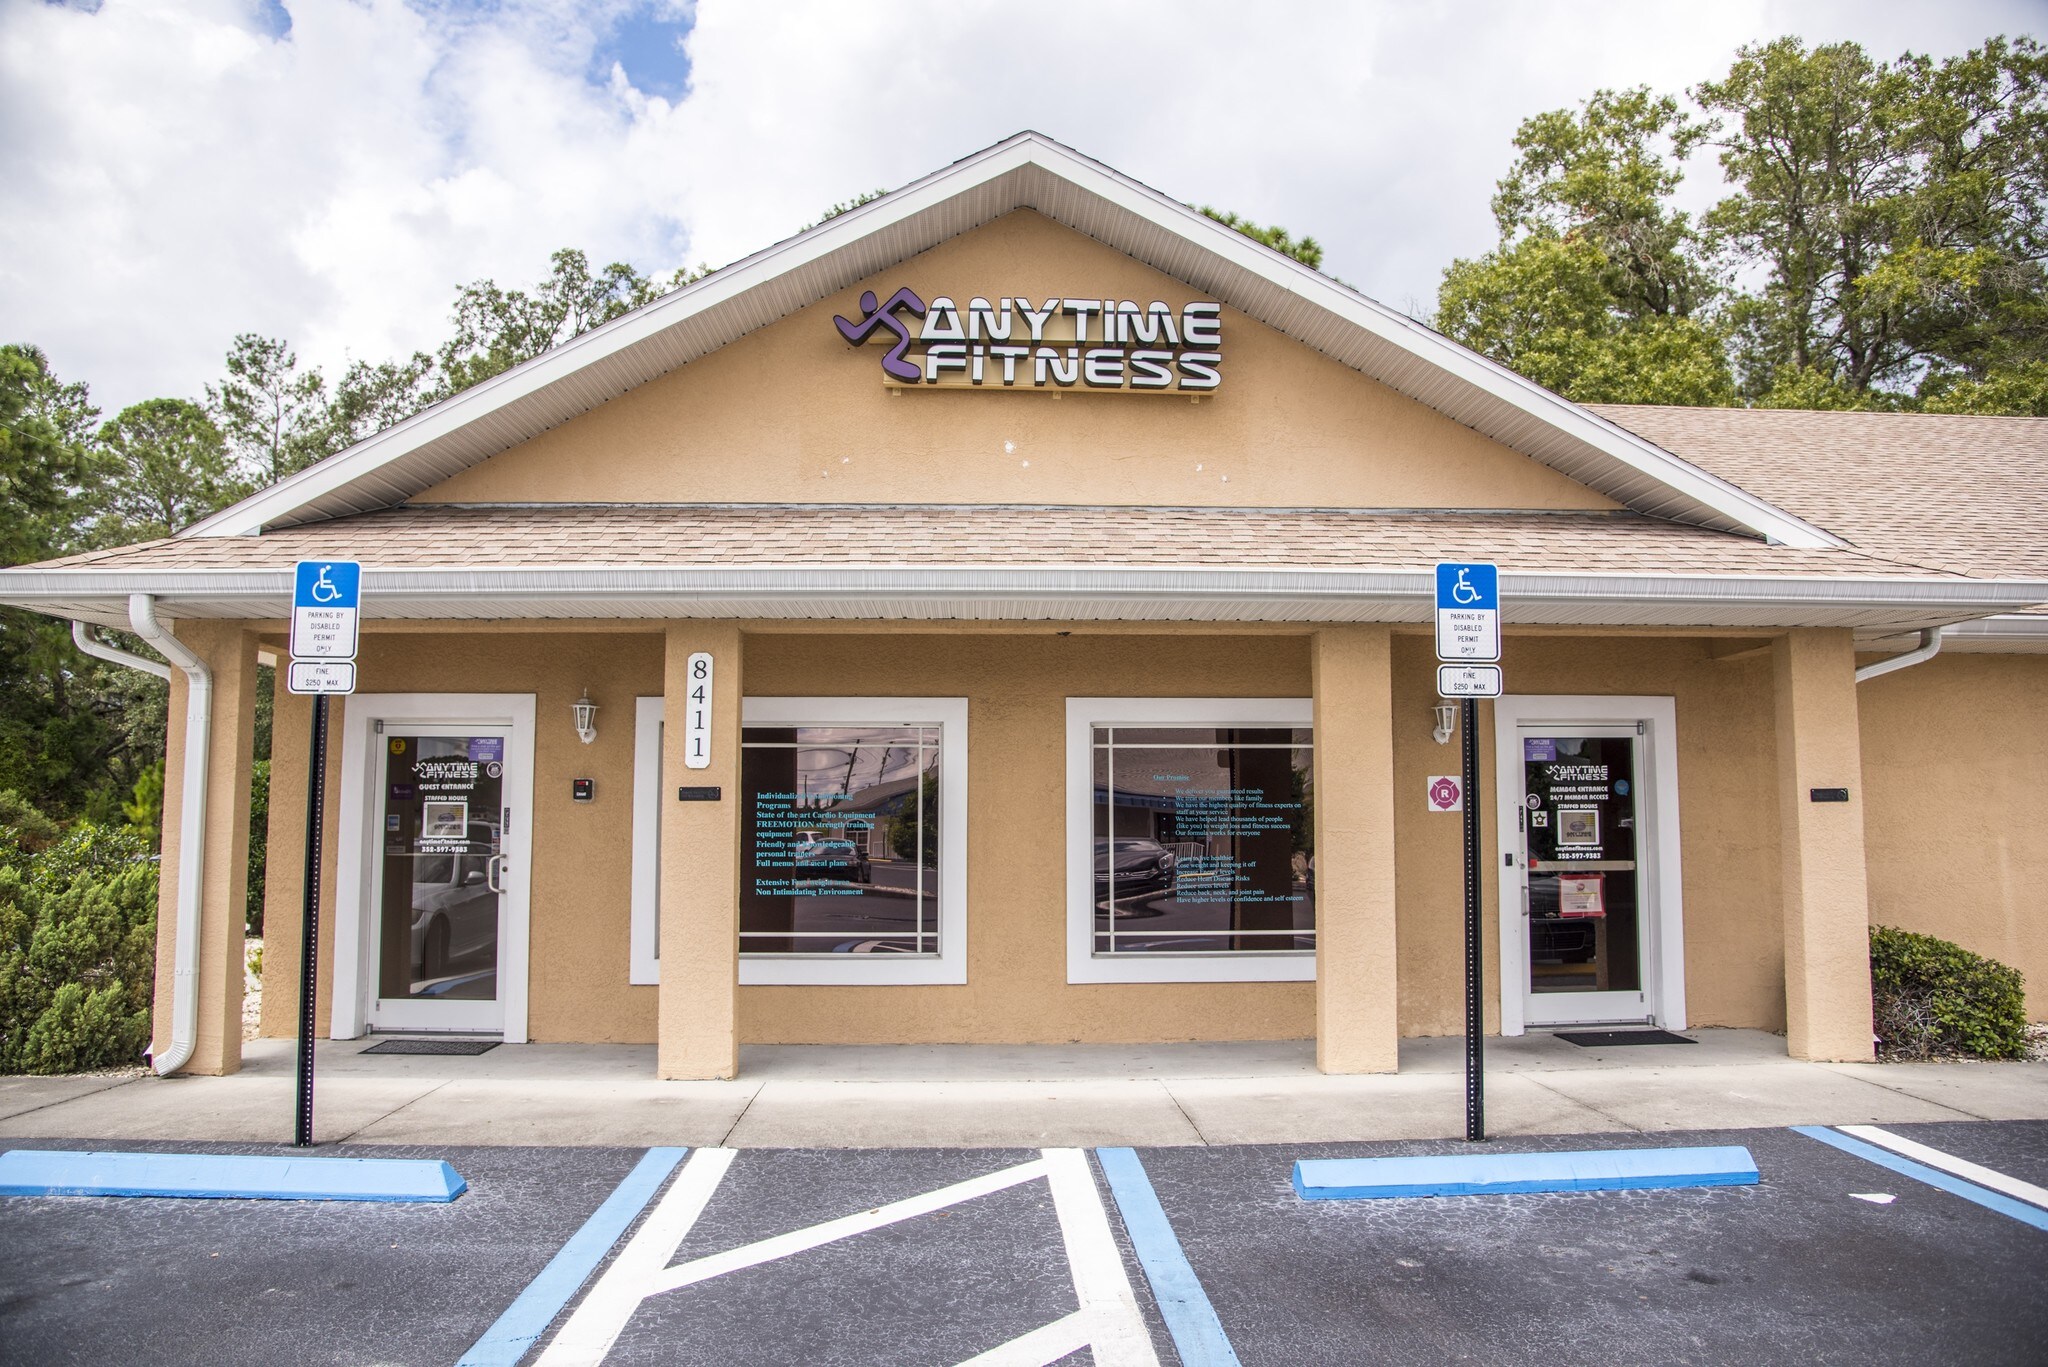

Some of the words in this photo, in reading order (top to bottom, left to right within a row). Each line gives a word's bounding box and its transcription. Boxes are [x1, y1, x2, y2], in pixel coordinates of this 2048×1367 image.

[919, 296, 1222, 350] ANYTIME
[925, 344, 1222, 389] FITNESS
[692, 660, 707, 757] 8411
[426, 762, 478, 771] ANYTIME
[1559, 765, 1608, 774] ANYTIME
[1441, 790, 1449, 798] R
